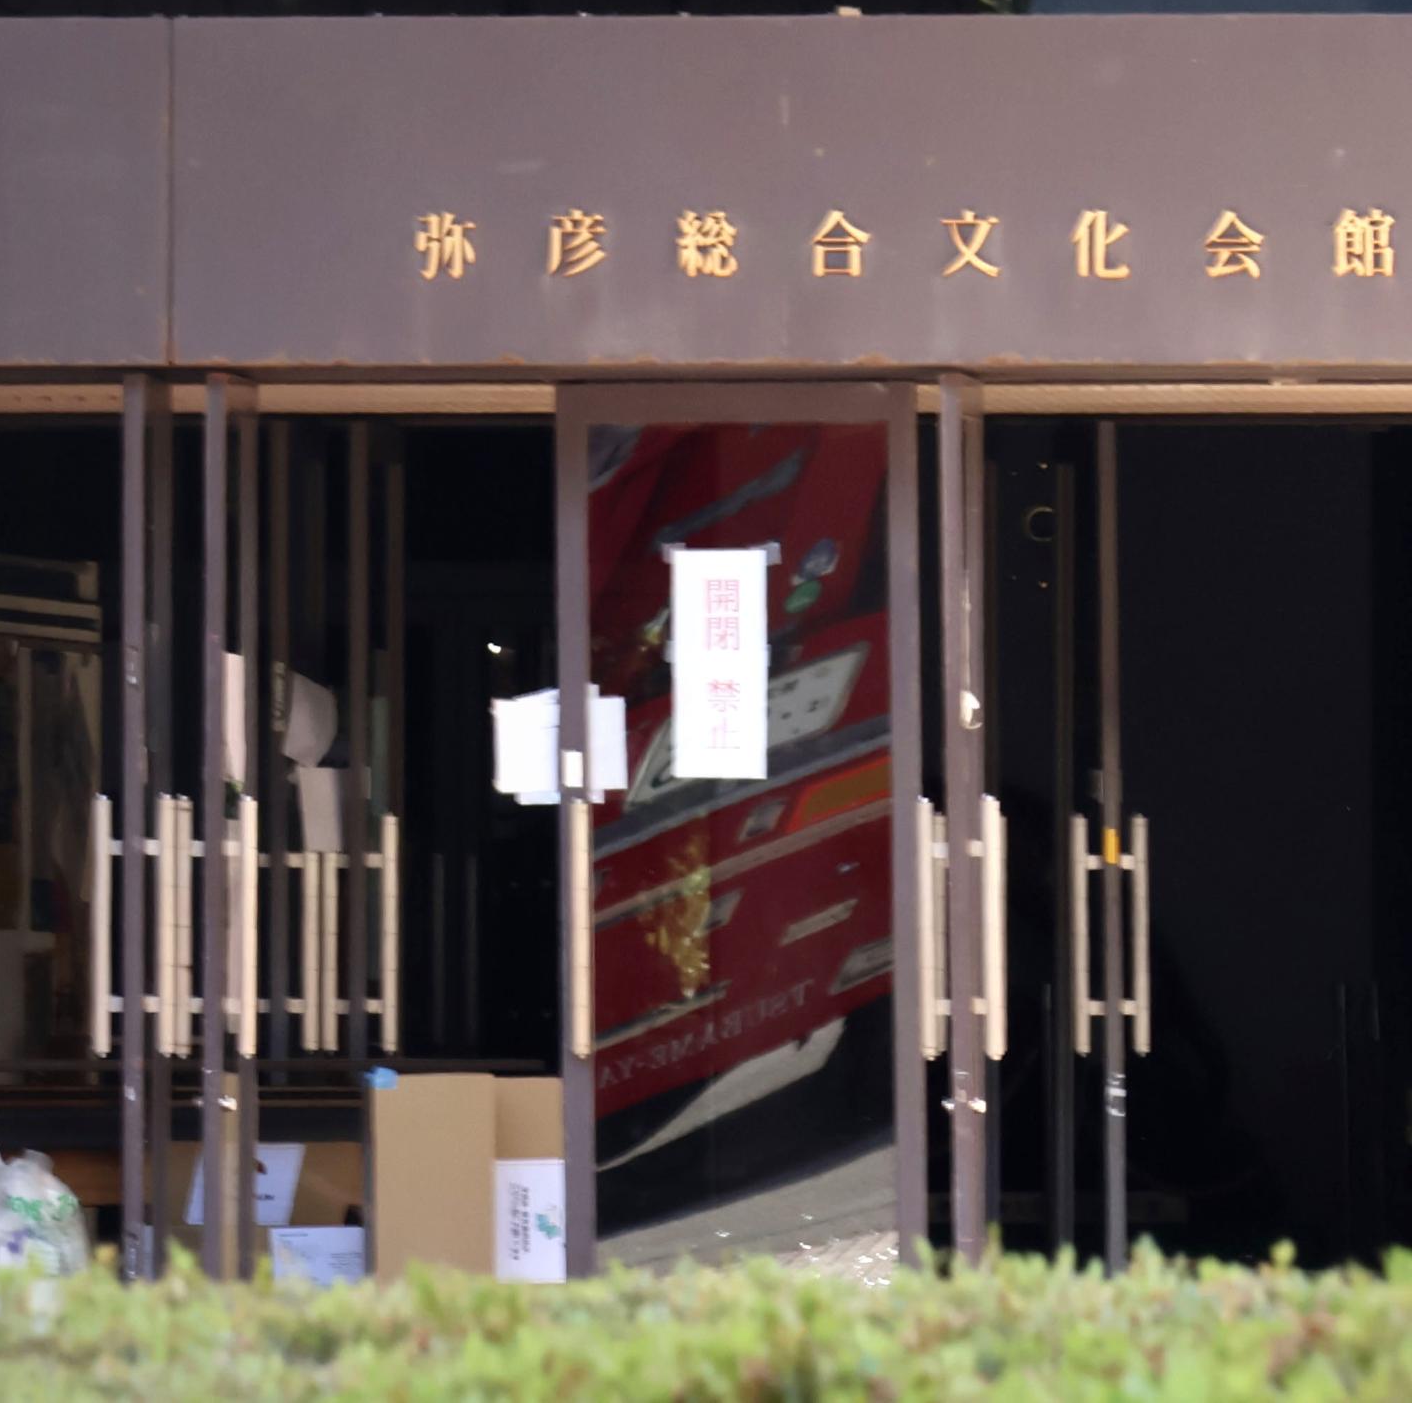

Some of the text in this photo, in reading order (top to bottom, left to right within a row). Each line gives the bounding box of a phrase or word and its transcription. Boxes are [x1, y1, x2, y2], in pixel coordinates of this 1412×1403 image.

[414, 208, 1394, 279] 弥彦総合文化会館
